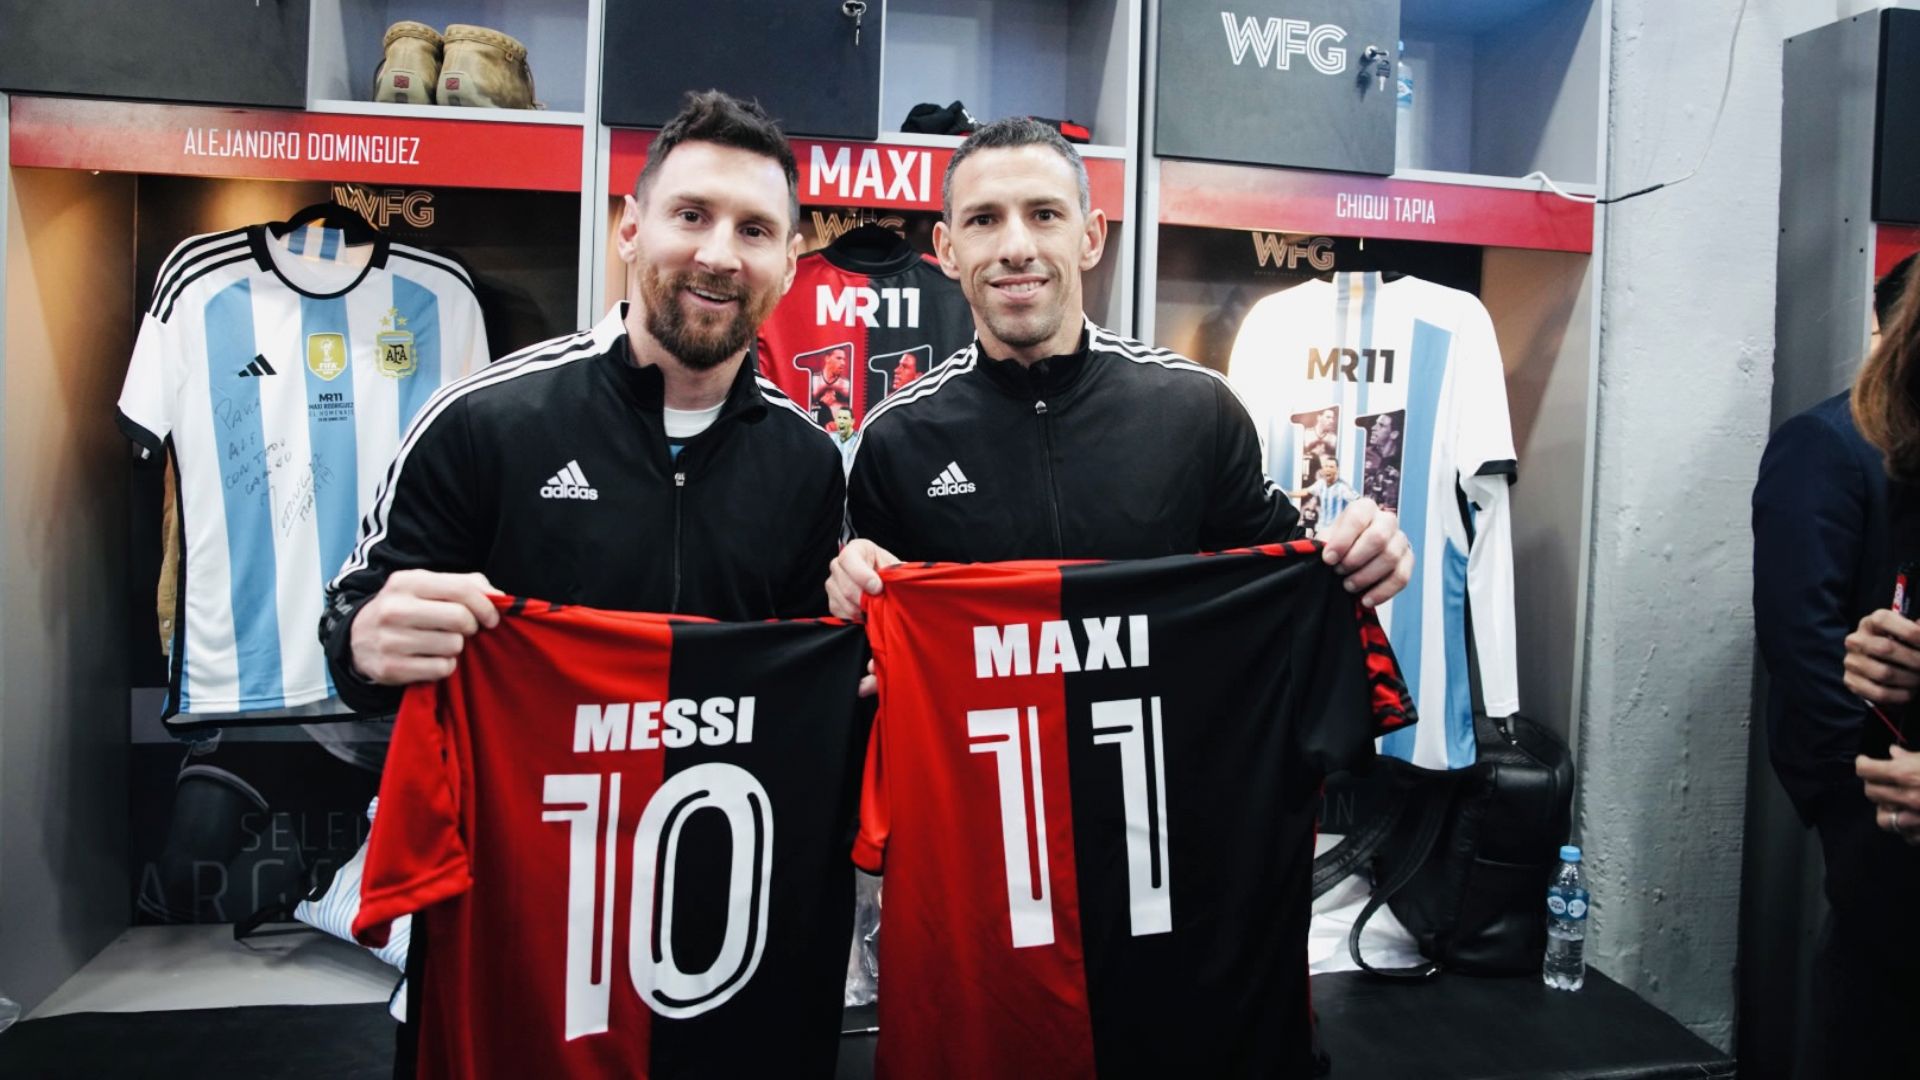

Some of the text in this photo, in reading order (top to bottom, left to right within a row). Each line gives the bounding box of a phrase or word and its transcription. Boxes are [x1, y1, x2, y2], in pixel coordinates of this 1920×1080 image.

[1221, 11, 1347, 75] WFG
[184, 127, 420, 165] ALEJANDRO DOMINGUEZ
[809, 145, 932, 202] MAXI
[1336, 192, 1436, 224] CHIQUI TAPIA
[1252, 231, 1335, 271] WFG
[816, 284, 920, 328] MR11
[385, 343, 408, 364] AFA
[1307, 347, 1395, 384] MR11
[319, 393, 343, 402] MR11
[540, 484, 599, 500] adidas
[927, 482, 976, 497] adidas
[973, 614, 1149, 678] MAXI
[573, 696, 756, 752] MESSI
[967, 696, 1172, 948] 11
[542, 762, 774, 1042] 10
